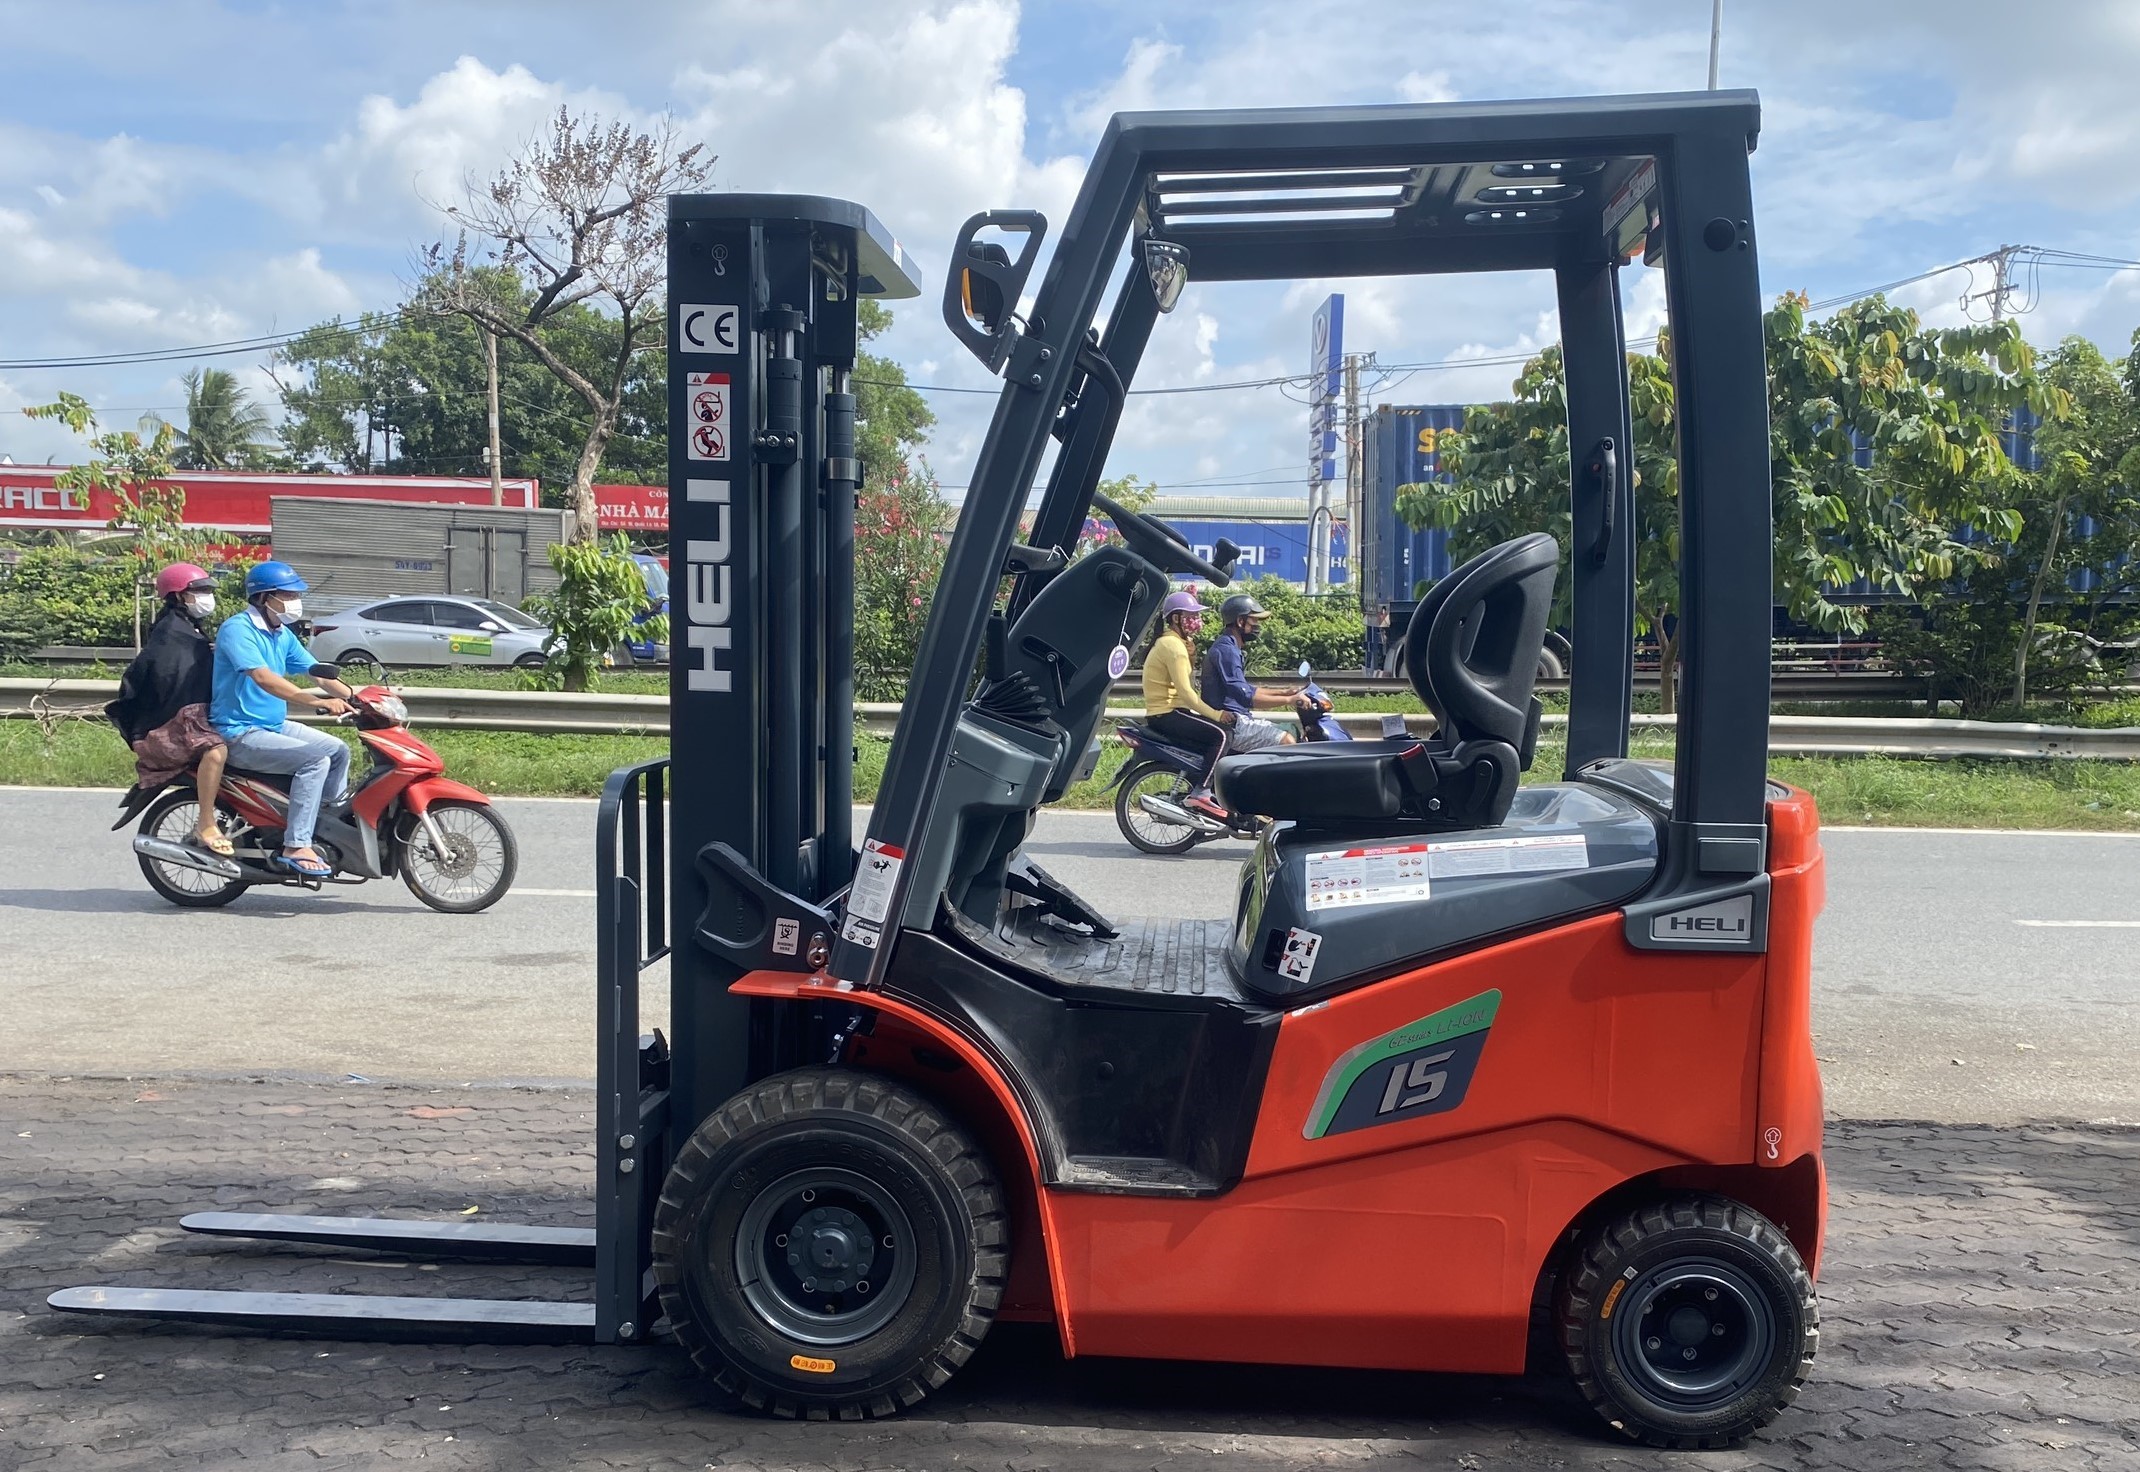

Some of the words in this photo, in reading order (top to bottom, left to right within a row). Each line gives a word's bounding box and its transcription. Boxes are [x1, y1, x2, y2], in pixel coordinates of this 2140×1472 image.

[684, 310, 735, 348] CE
[686, 478, 732, 693] HELI
[1669, 915, 1746, 934] HELI
[1378, 1048, 1457, 1114] 15
